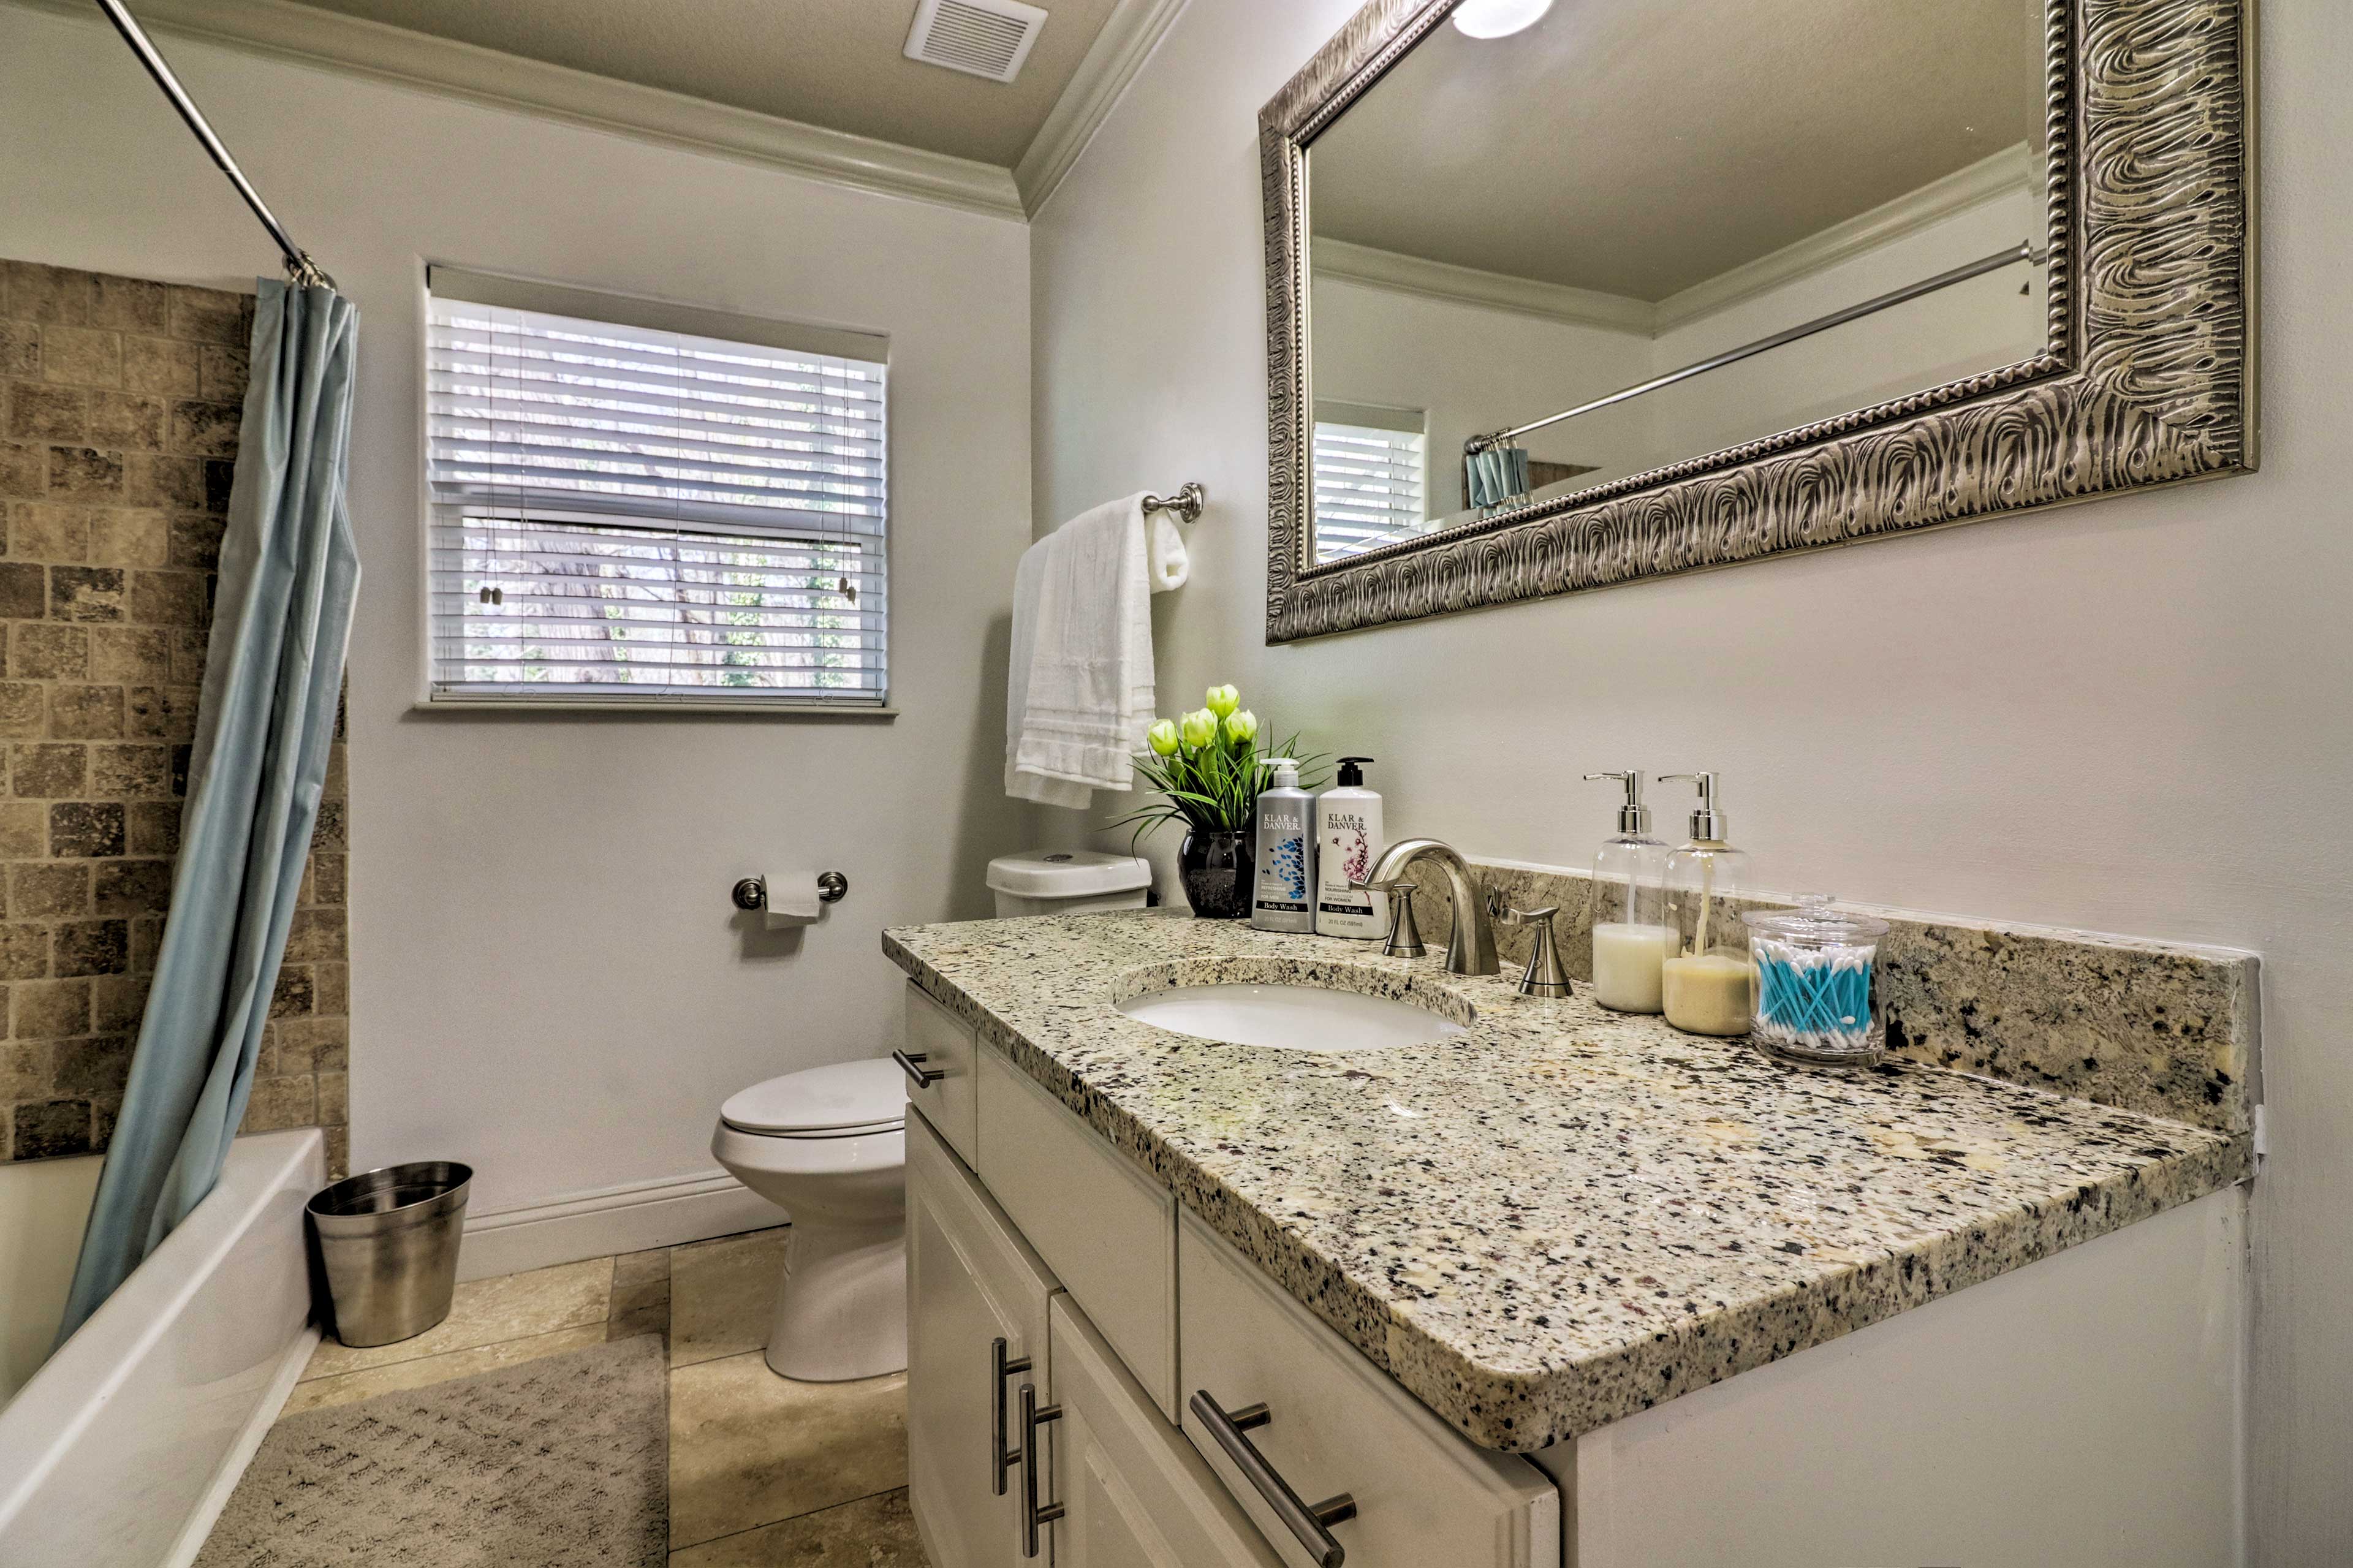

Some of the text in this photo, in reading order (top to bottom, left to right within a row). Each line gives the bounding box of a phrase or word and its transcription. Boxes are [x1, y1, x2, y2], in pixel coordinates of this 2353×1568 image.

[1264, 814, 1290, 822] KLAR
[1328, 813, 1355, 822] KLAR
[1264, 902, 1278, 911] Body
